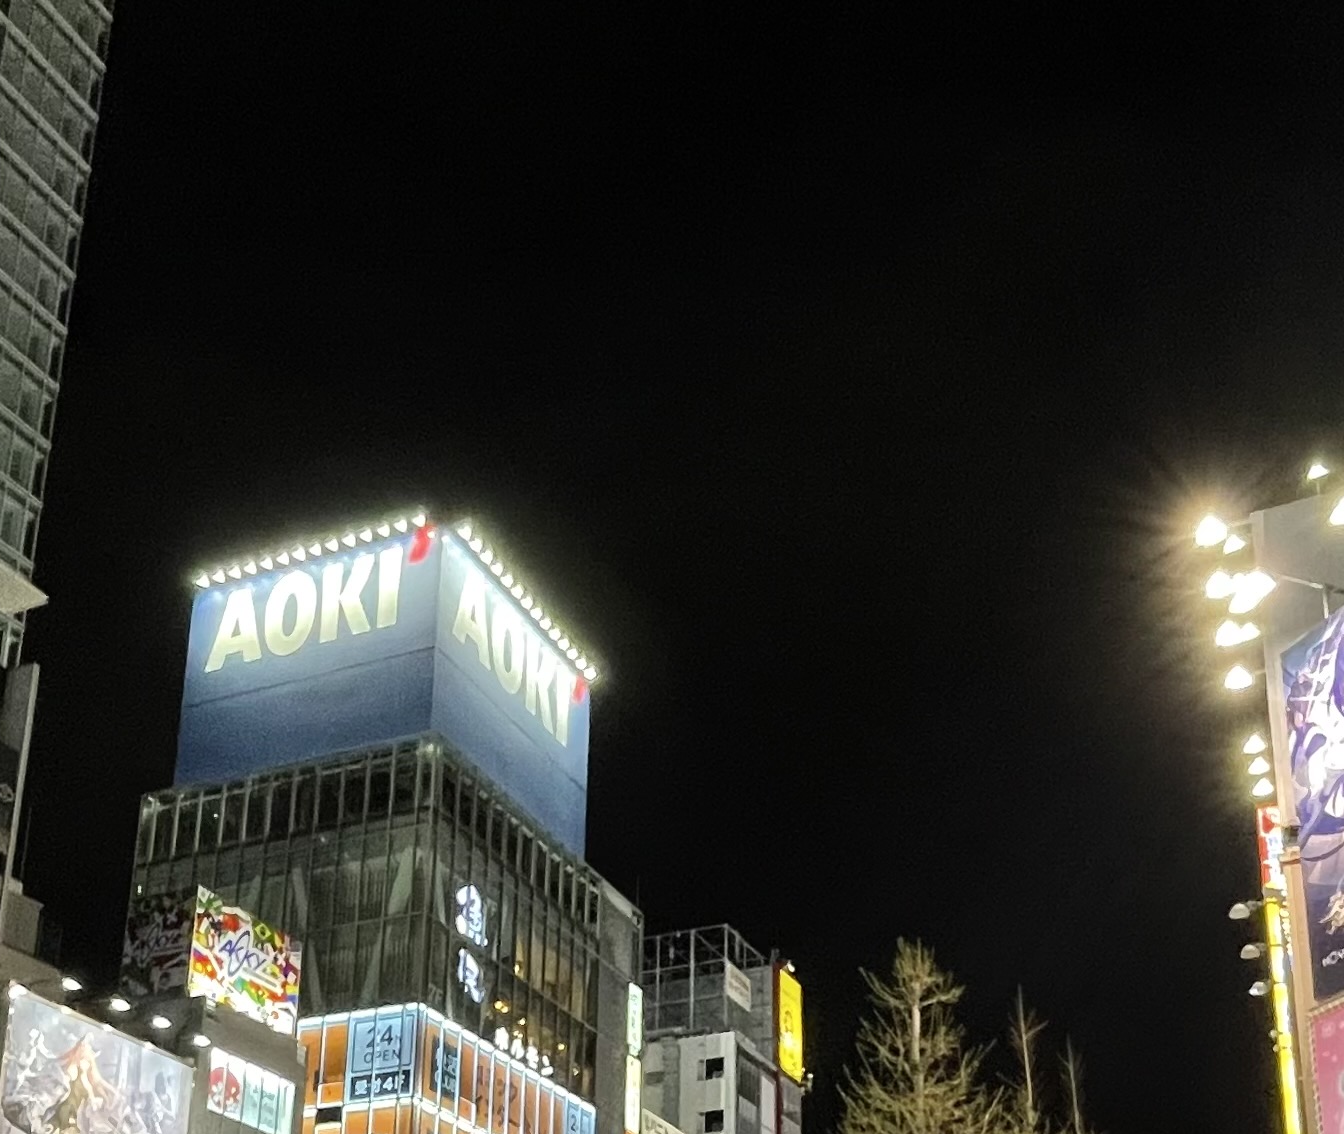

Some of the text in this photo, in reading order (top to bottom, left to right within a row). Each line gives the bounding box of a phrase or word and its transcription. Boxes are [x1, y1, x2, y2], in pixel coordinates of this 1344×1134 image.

[204, 544, 405, 674] AOKI
[452, 566, 577, 748] AOKI
[362, 1047, 402, 1065] OPEN
